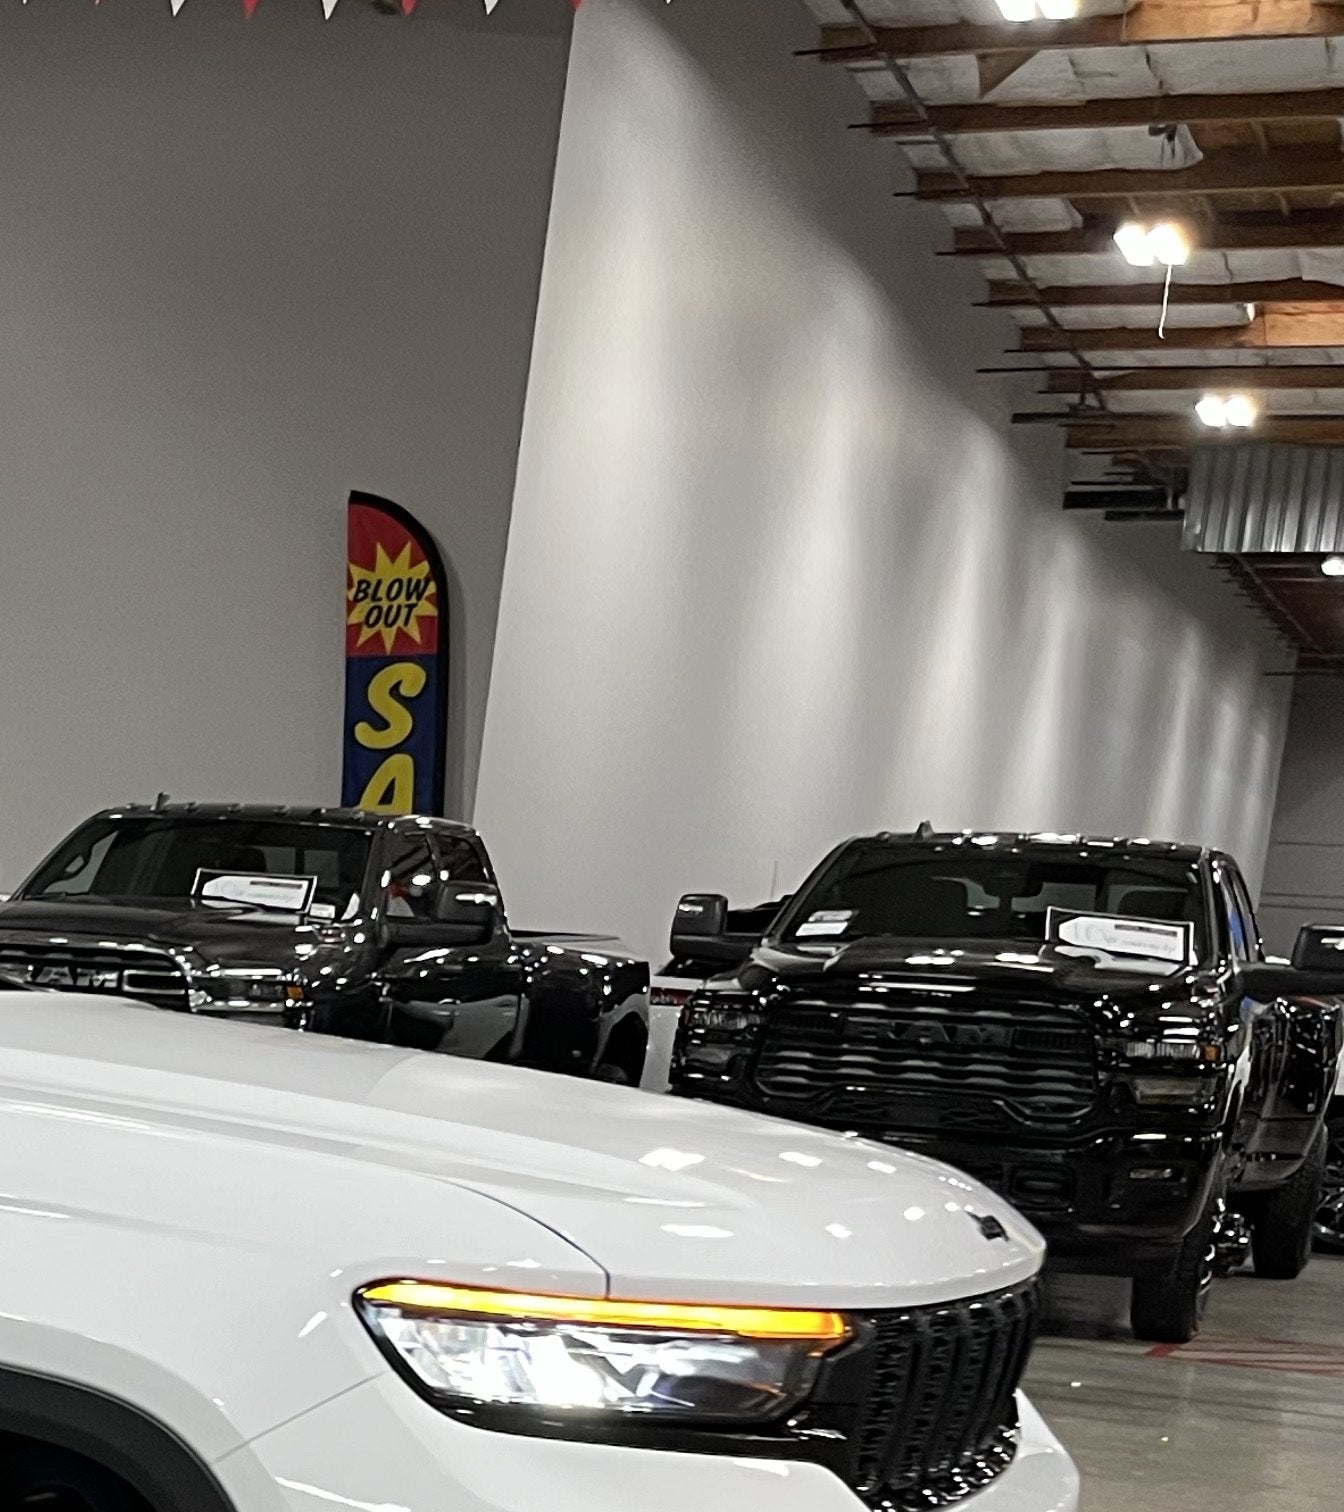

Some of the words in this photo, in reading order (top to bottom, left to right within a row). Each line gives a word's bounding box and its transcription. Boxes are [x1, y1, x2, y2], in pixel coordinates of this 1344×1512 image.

[353, 576, 430, 602] BLOW
[365, 602, 418, 629] OUT
[843, 1016, 1013, 1046] RAM
